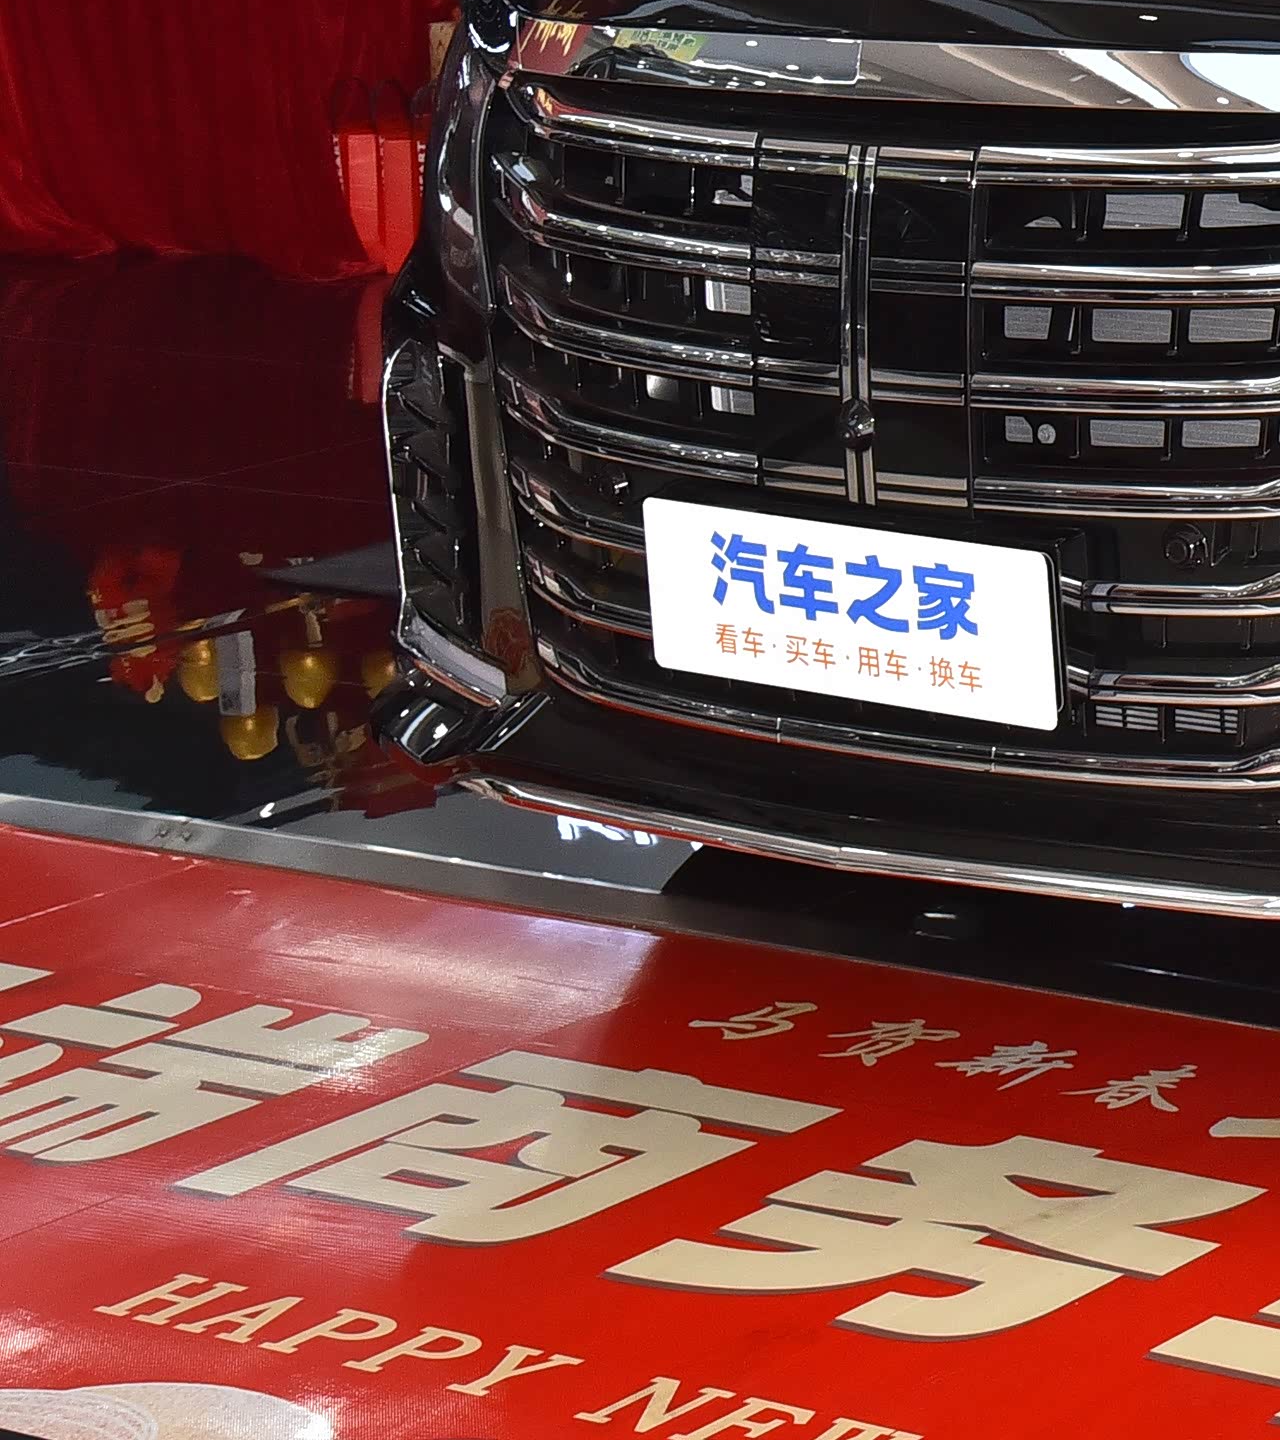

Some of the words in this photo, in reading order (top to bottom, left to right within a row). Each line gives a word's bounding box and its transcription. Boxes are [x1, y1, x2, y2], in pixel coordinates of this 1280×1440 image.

[710, 530, 979, 641] 汽车之家
[688, 998, 1209, 1115] 马贺新春
[94, 1271, 588, 1401] HAPPY
